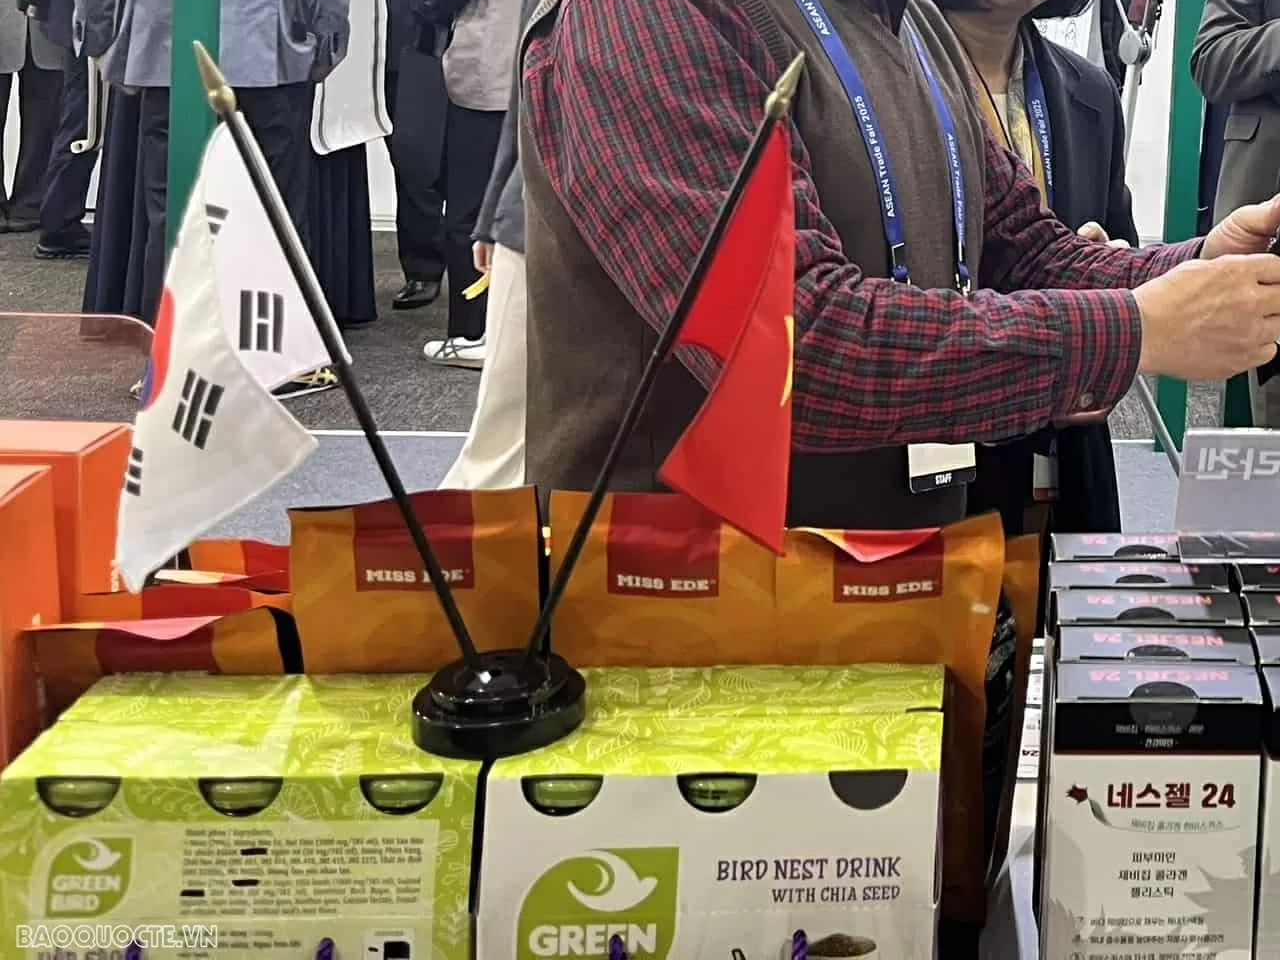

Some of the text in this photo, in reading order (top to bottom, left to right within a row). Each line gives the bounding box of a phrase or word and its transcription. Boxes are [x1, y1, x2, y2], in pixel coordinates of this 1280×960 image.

[805, 2, 831, 35] ASEAN
[854, 96, 896, 218] ASEAN Trade Fair 2025
[366, 568, 417, 583] MISS
[616, 574, 710, 591] MISS EDE
[842, 580, 934, 596] MISS EDE
[1107, 783, 1236, 809] 네스젤 24
[716, 856, 902, 881] BIRD NEST DRINK
[1131, 851, 1176, 864] 피부미인
[772, 884, 902, 904] WITH CHIA SEED
[528, 922, 657, 957] GREEN
